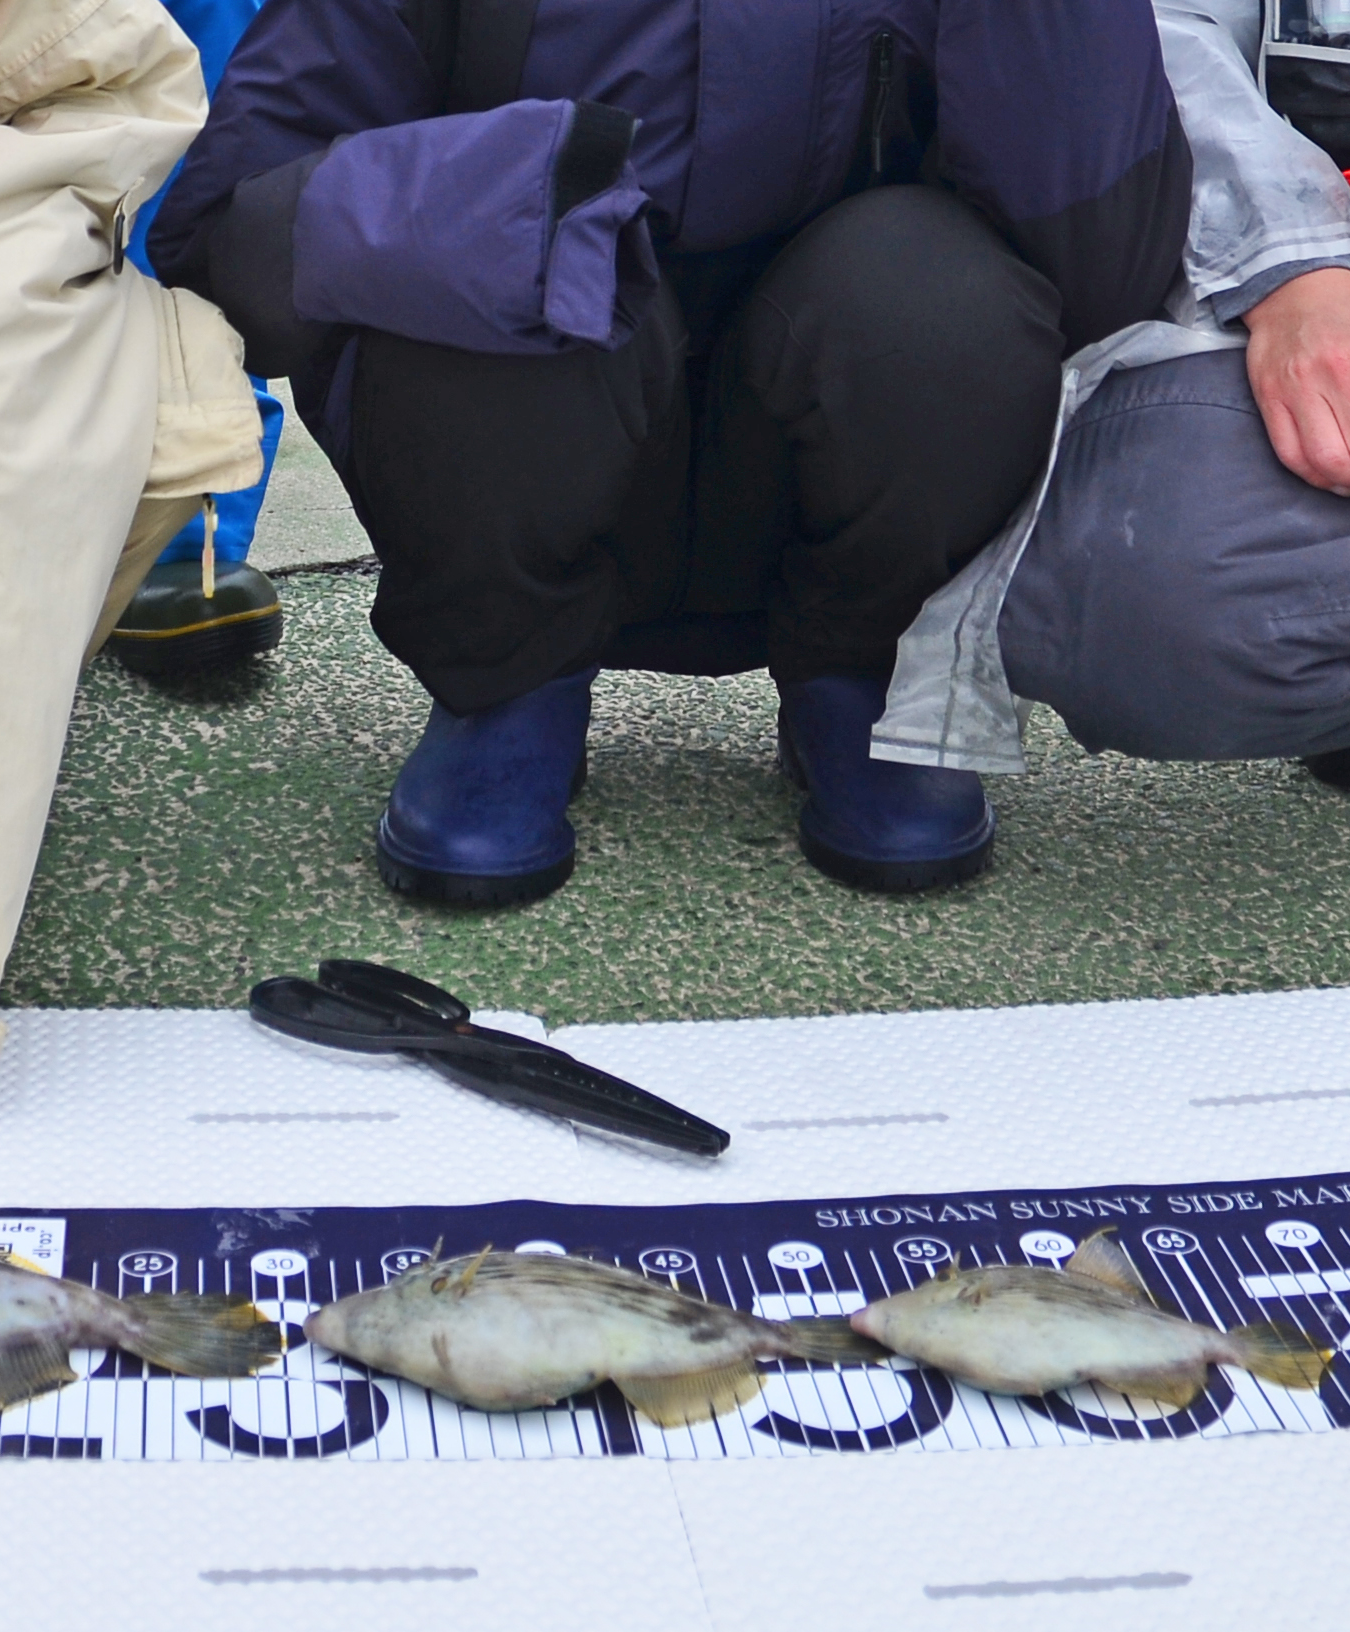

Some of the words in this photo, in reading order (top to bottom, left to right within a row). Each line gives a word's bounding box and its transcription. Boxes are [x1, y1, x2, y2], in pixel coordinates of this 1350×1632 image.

[816, 1202, 998, 1229] SHONAN
[1012, 1196, 1152, 1220] SUNNY
[1166, 1191, 1264, 1215] SIDE
[132, 1255, 164, 1272] 25
[264, 1255, 295, 1273] 30
[652, 1252, 682, 1270] 45
[782, 1247, 811, 1265] 50
[907, 1241, 938, 1260] 55
[1032, 1235, 1062, 1254] 60
[1154, 1231, 1187, 1251] 65
[1275, 1223, 1311, 1245] 70
